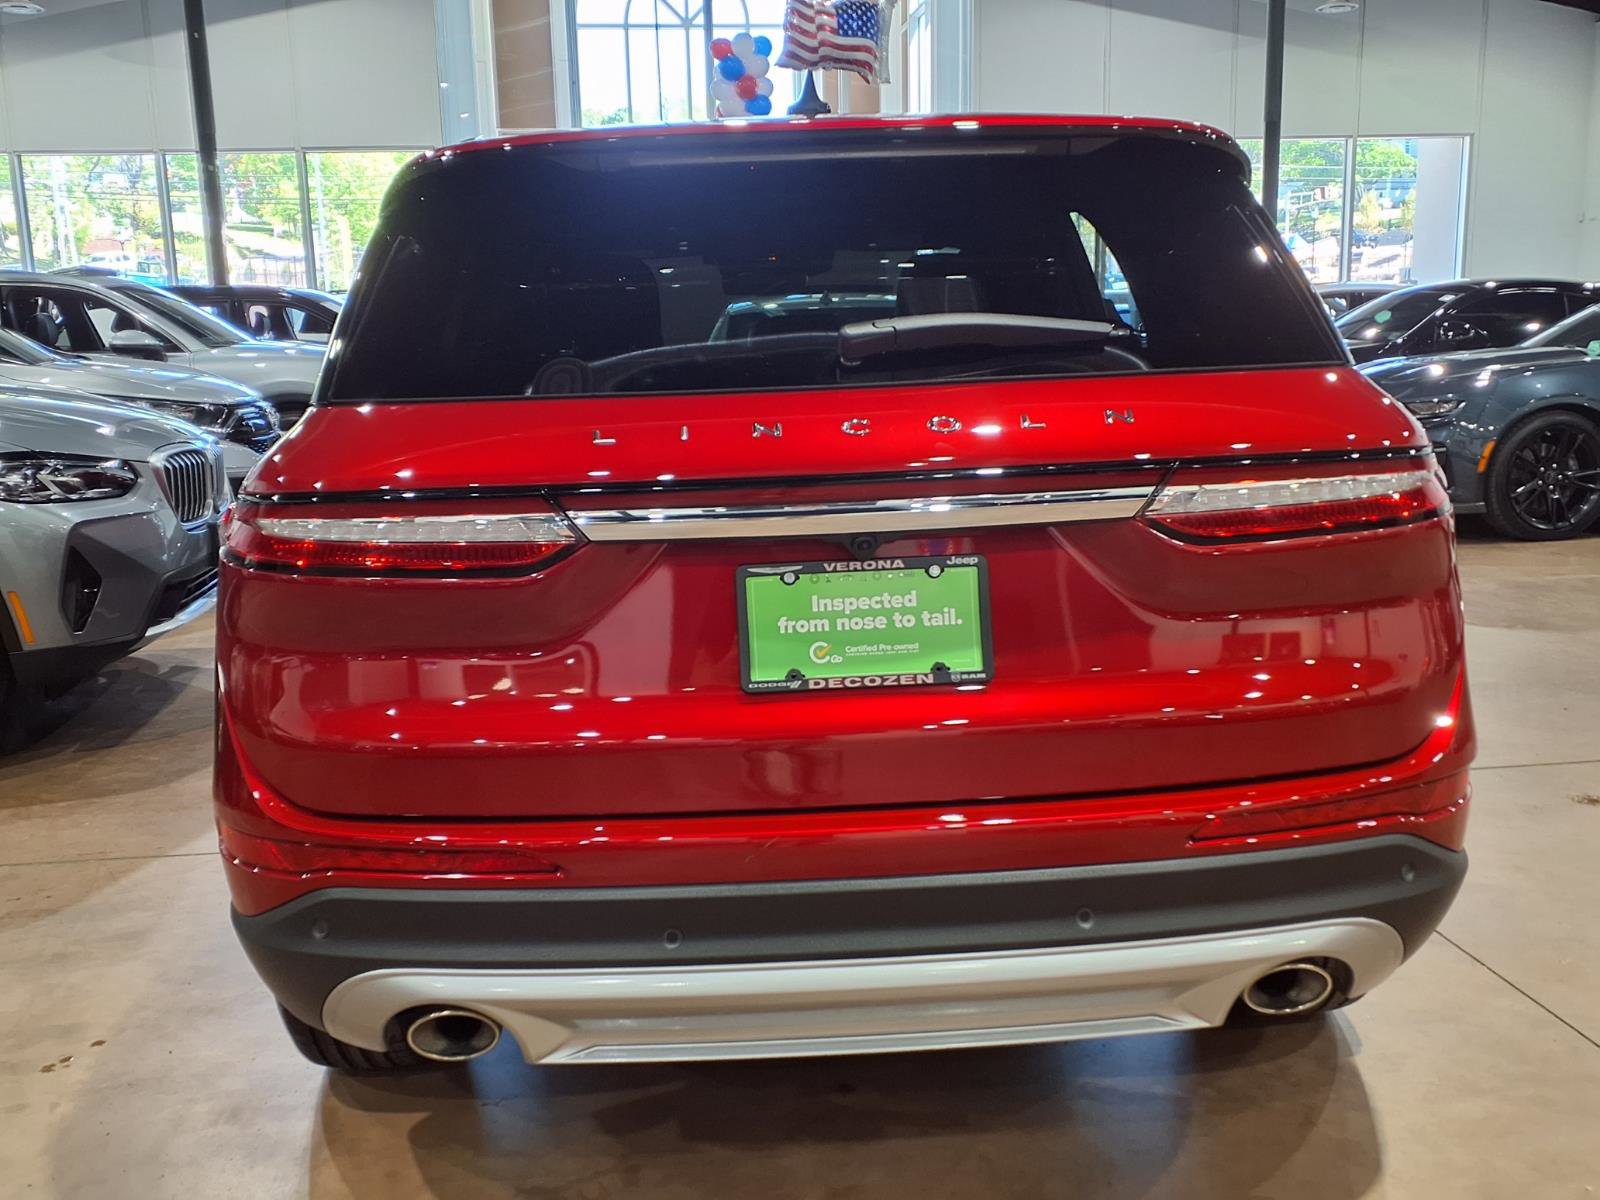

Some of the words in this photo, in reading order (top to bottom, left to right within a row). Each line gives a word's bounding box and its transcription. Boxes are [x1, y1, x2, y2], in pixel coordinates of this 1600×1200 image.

[592, 409, 1134, 446] LINCOLN
[823, 559, 905, 571] VERONA
[946, 556, 979, 565] Jeep
[811, 590, 917, 614] Inspected
[777, 616, 830, 634] from
[836, 614, 887, 631] nose
[892, 612, 916, 628] to
[921, 608, 963, 627] tail.
[845, 644, 877, 653] Certified
[808, 674, 934, 690] DECOZEN
